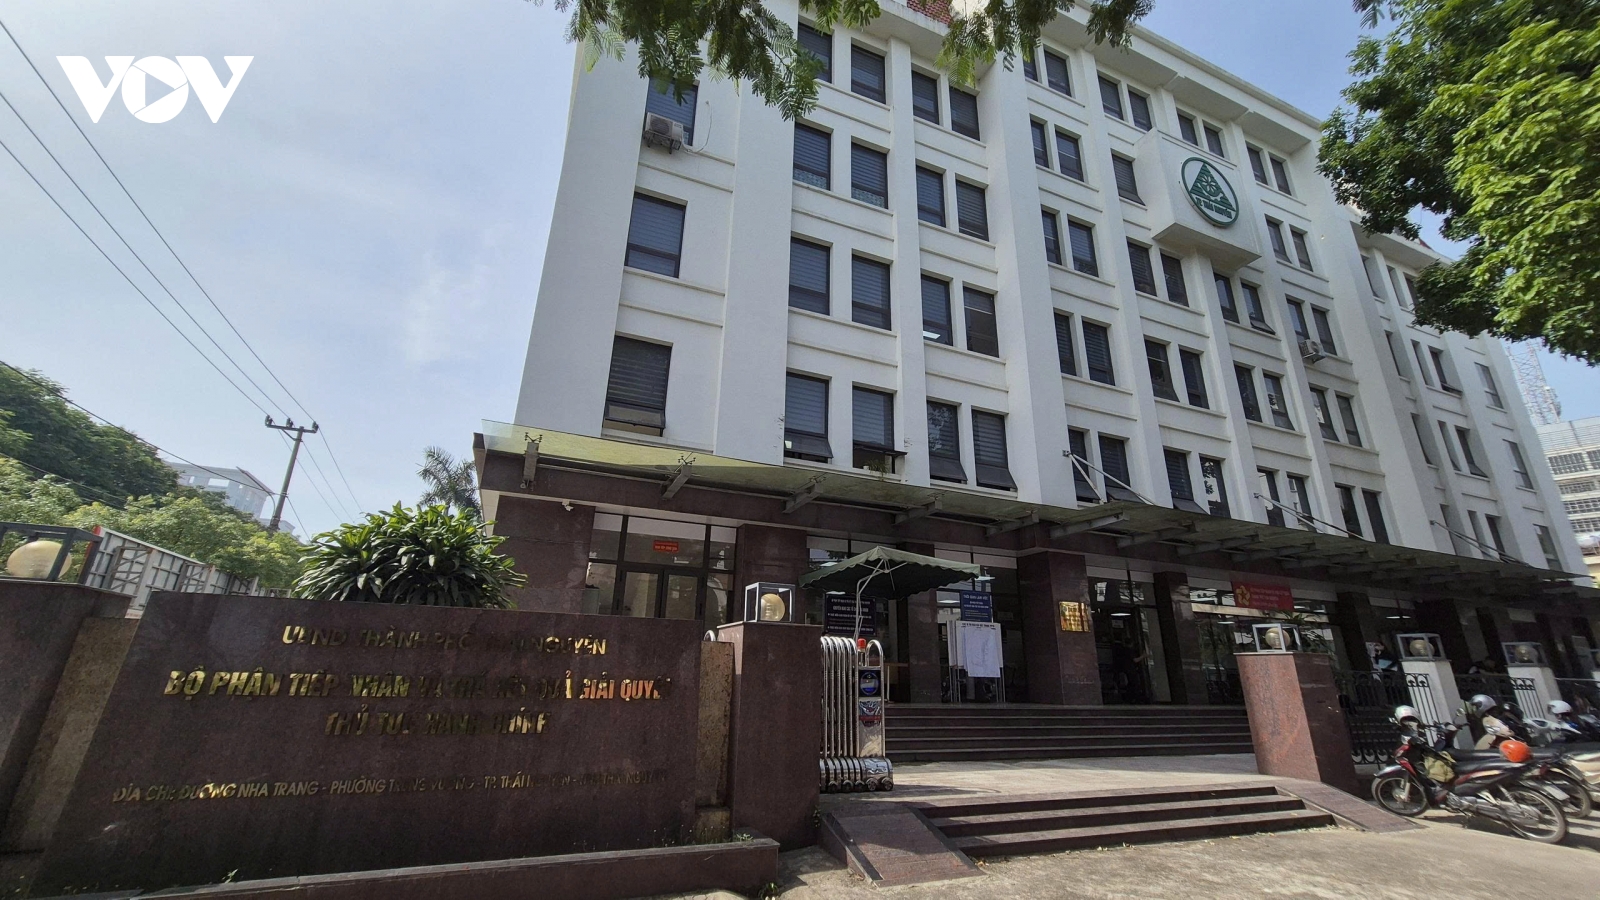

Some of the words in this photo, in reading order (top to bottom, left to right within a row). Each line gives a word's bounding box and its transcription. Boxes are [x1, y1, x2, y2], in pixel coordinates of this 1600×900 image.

[282, 624, 347, 646] UBND
[163, 665, 206, 701] BỘ
[579, 671, 616, 700] GIẢI
[237, 783, 268, 798] NHA
[273, 781, 319, 797] TRANG
[330, 776, 387, 795] PHƯỜNG
